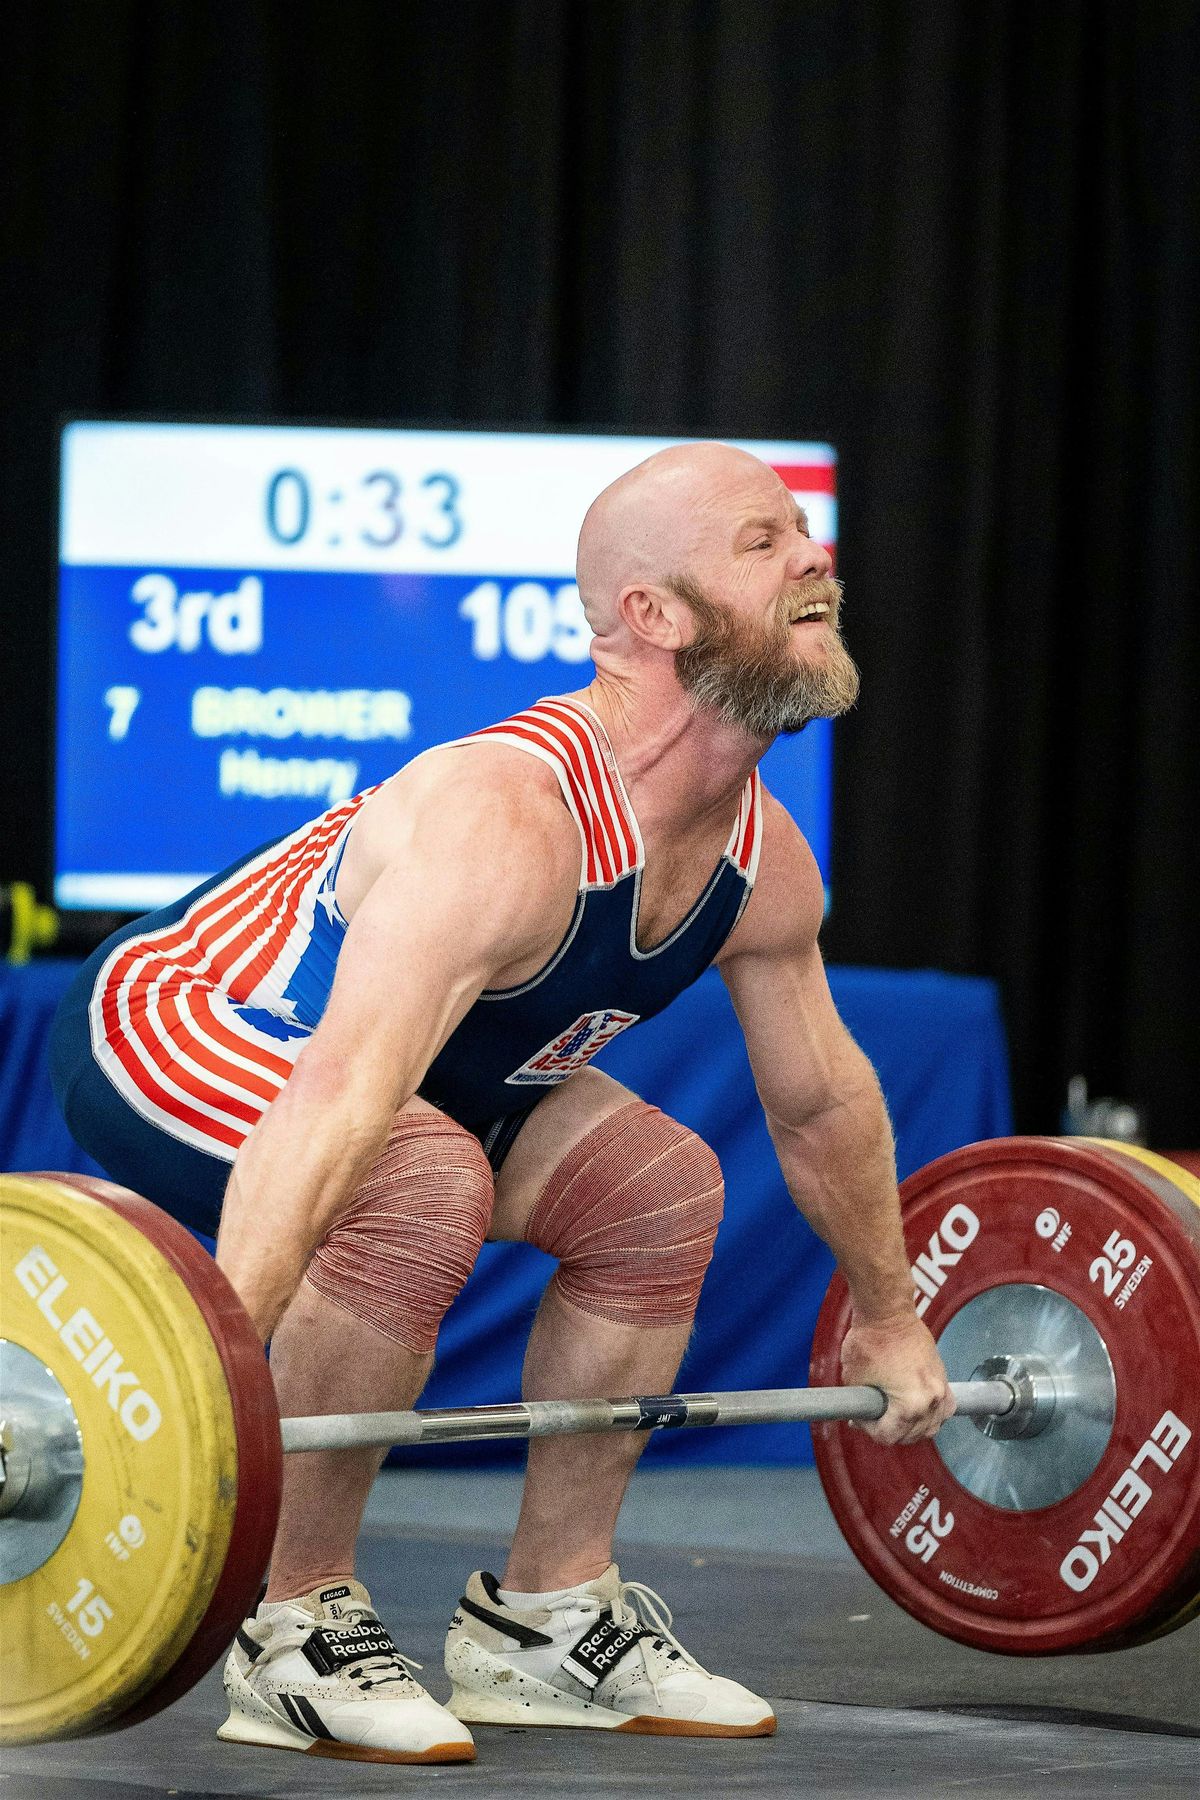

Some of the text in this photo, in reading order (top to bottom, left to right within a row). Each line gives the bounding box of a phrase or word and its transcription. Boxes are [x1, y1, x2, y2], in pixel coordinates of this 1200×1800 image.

[264, 466, 464, 547] 0:33
[128, 575, 264, 655] 3rd
[104, 686, 413, 741] 7 BROWER
[218, 747, 359, 806] Henry
[912, 1203, 980, 1318] IKO
[1051, 1221, 1073, 1253] IWF
[1089, 1229, 1136, 1297] 25
[1114, 1255, 1153, 1310] SWEDEN
[13, 1245, 162, 1441] ELEIKO
[889, 1484, 930, 1538] SWEDEN
[905, 1497, 955, 1563] 25
[1059, 1409, 1193, 1592] ELEIKO
[66, 1578, 113, 1637] 15
[323, 1589, 346, 1600] LEGACY
[939, 1570, 999, 1600] COMPETITION
[48, 1602, 91, 1660] SWEDEN
[578, 1615, 627, 1658] Reeb
